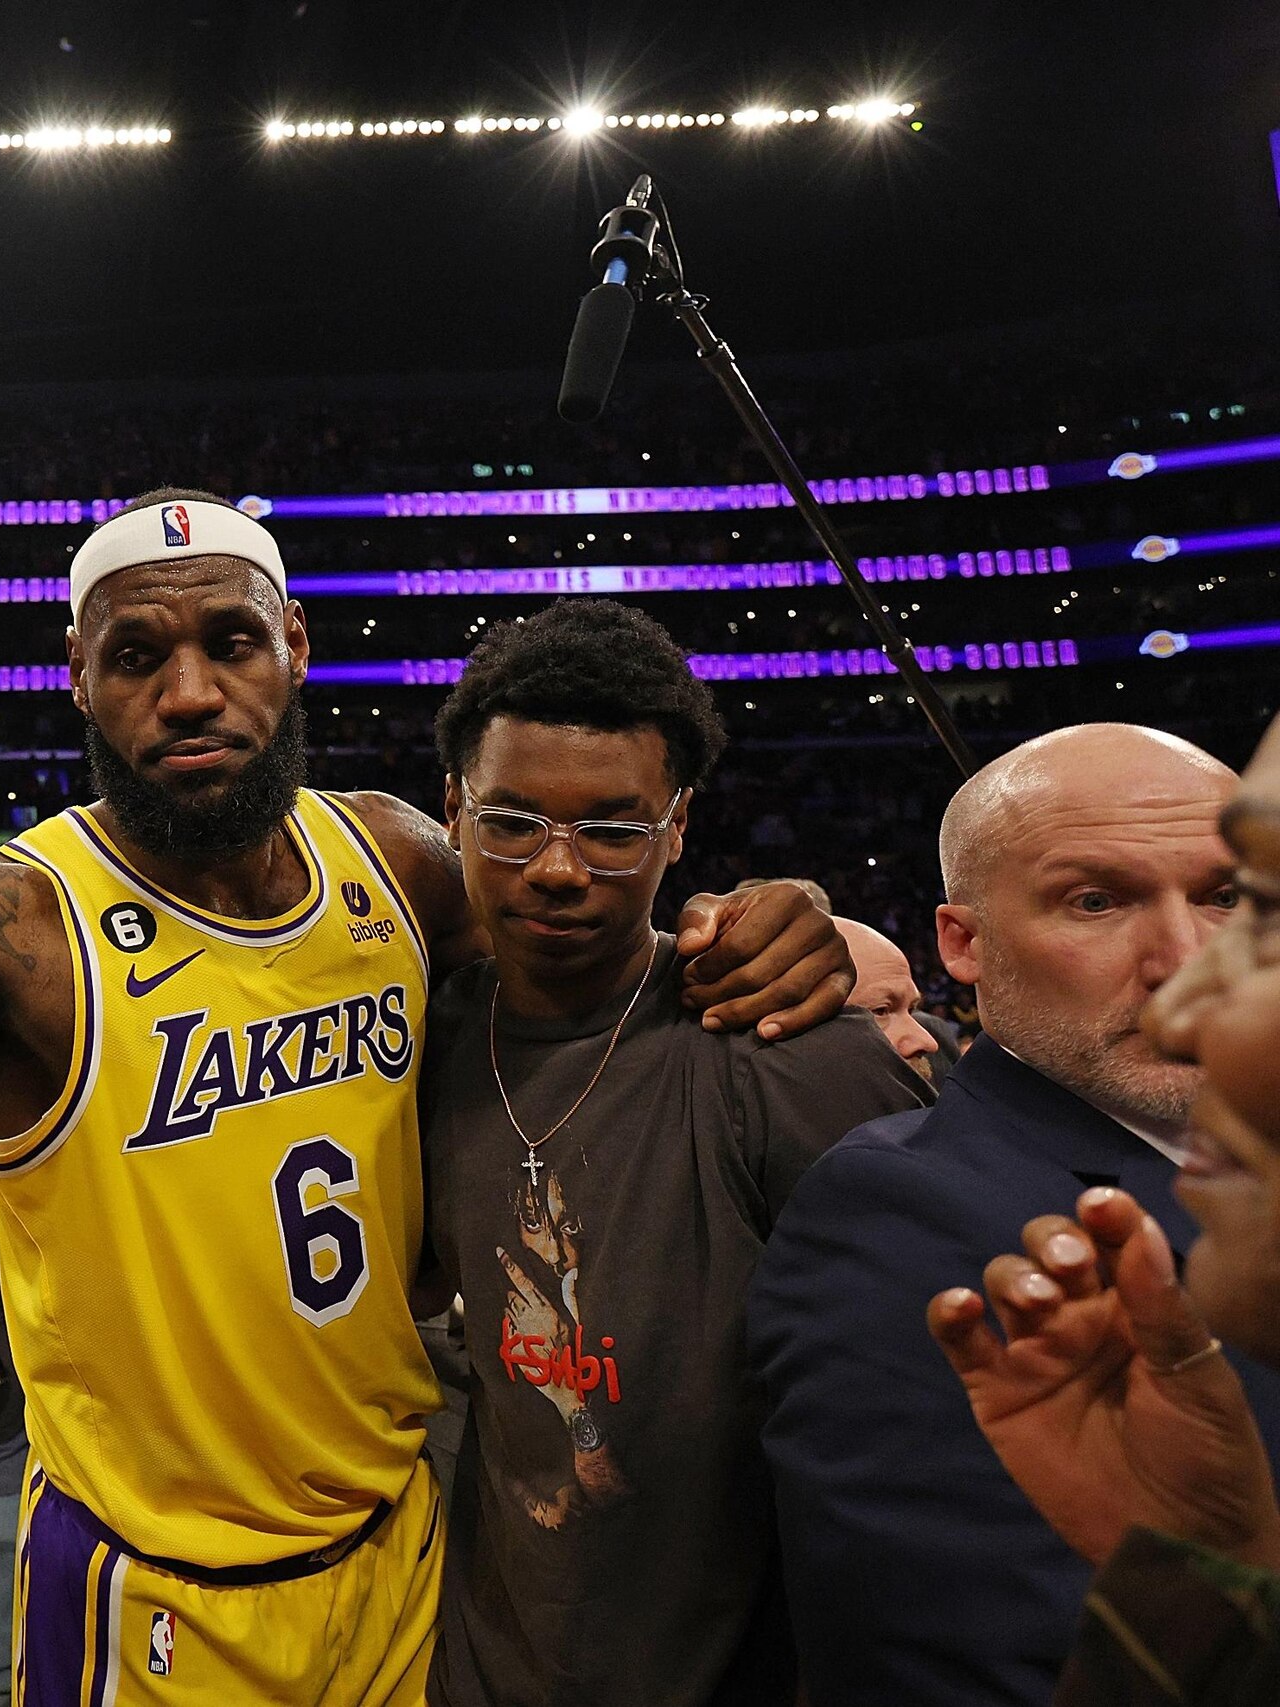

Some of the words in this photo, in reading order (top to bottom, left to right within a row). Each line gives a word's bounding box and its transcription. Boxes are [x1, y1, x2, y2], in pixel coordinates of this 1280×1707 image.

[167, 535, 184, 545] NBA
[110, 909, 145, 947] 6
[347, 918, 396, 944] bibigo
[122, 984, 414, 1153] LAKERS
[271, 1133, 370, 1329] 6
[150, 1660, 164, 1672] NBA
